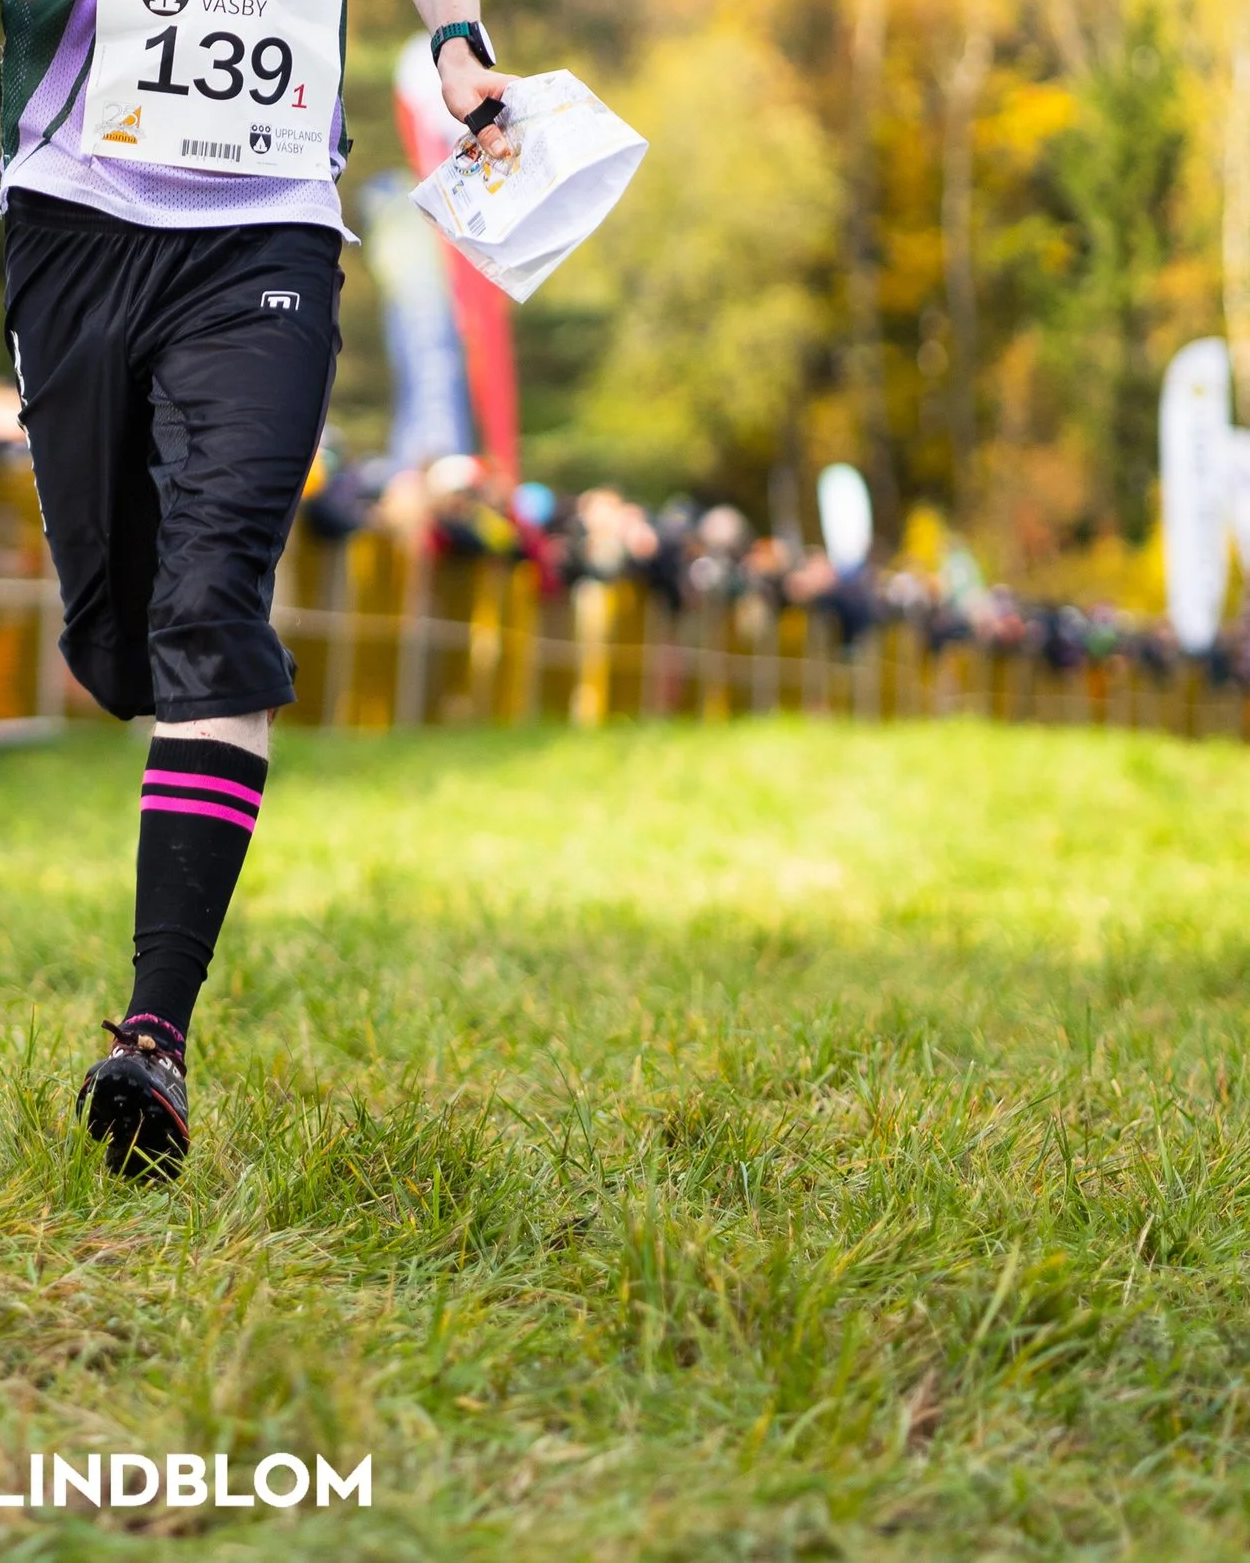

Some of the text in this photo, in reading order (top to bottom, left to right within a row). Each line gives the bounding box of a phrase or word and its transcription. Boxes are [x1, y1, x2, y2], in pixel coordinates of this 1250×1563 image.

[137, 25, 293, 106] 139
[291, 83, 308, 109] 1
[275, 128, 323, 143] UPPLANDS
